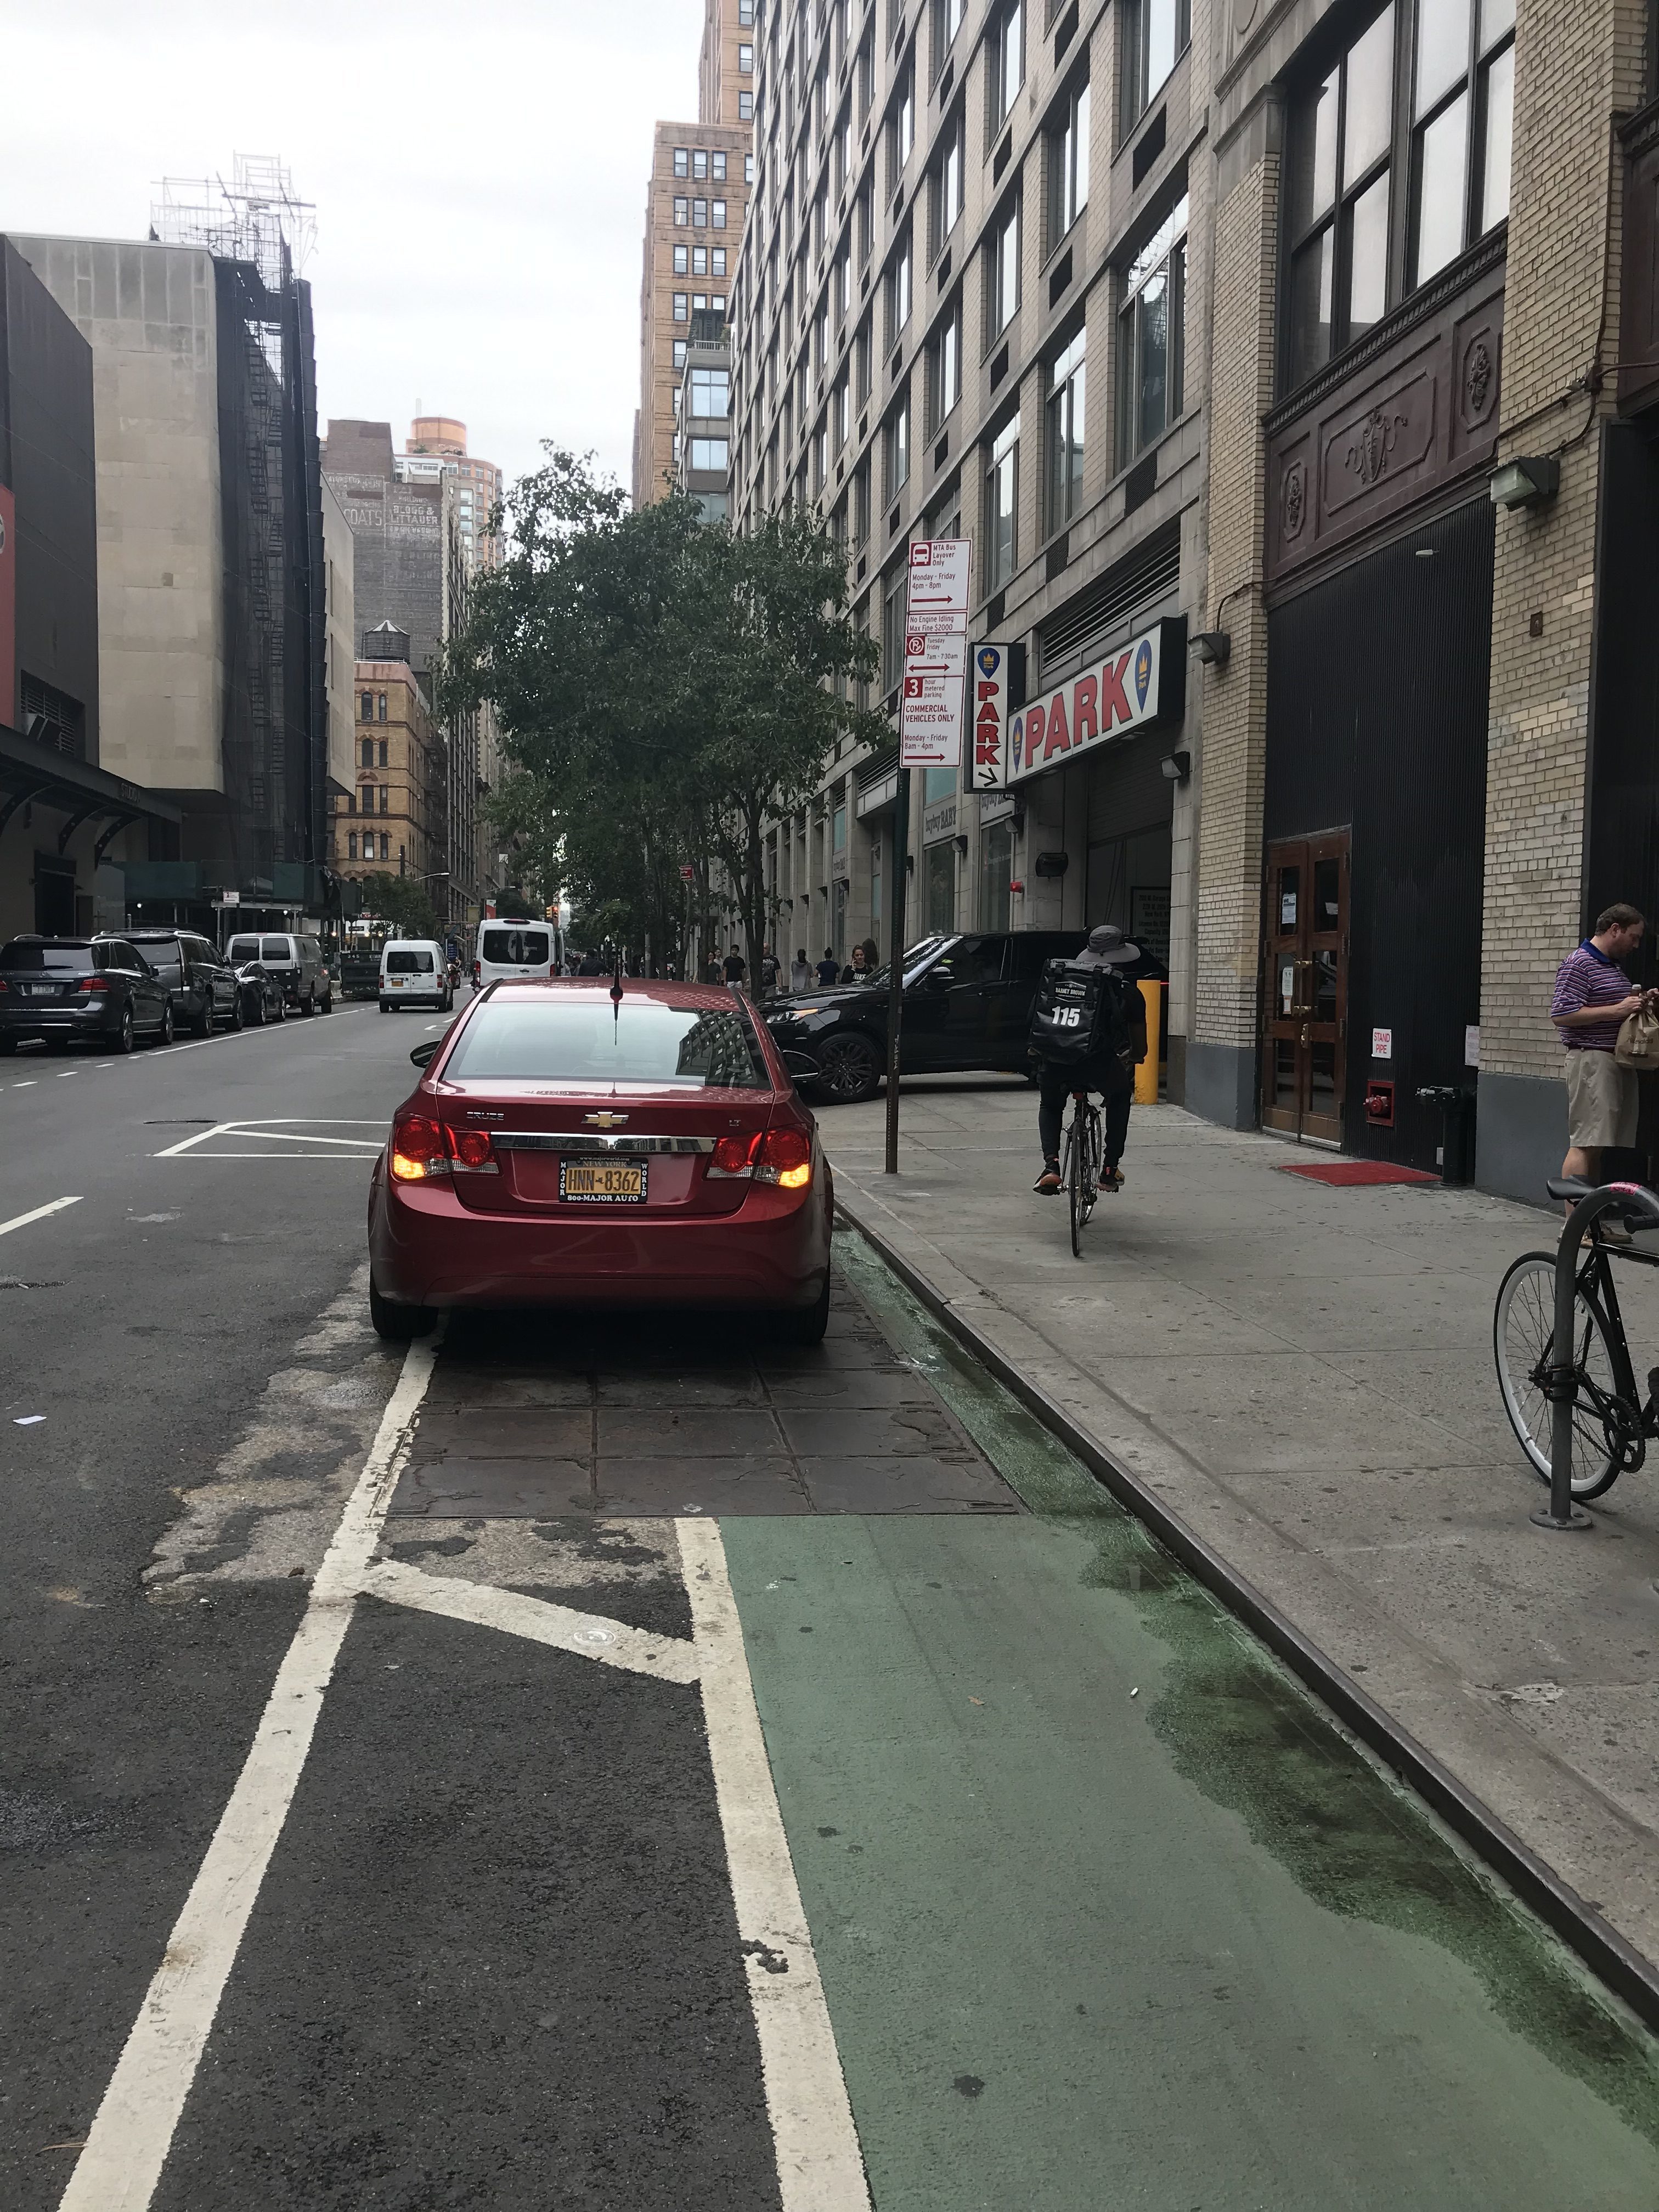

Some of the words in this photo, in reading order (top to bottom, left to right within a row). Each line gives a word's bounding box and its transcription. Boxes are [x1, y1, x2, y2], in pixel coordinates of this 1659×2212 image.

[919, 616, 937, 624] Engine
[934, 624, 953, 632] $2000
[909, 679, 918, 696] 3
[906, 704, 947, 713] COMMERCIAL
[1025, 647, 1135, 770] PARK
[905, 714, 936, 723] VEHICLES
[938, 714, 955, 722] ONLY
[976, 681, 1001, 765] PARK
[922, 742, 933, 751] 4pm
[1052, 1006, 1080, 1027] 115
[1374, 1032, 1390, 1042] STAND
[1376, 1043, 1387, 1054] PIPE
[466, 1111, 504, 1120] CRUZE
